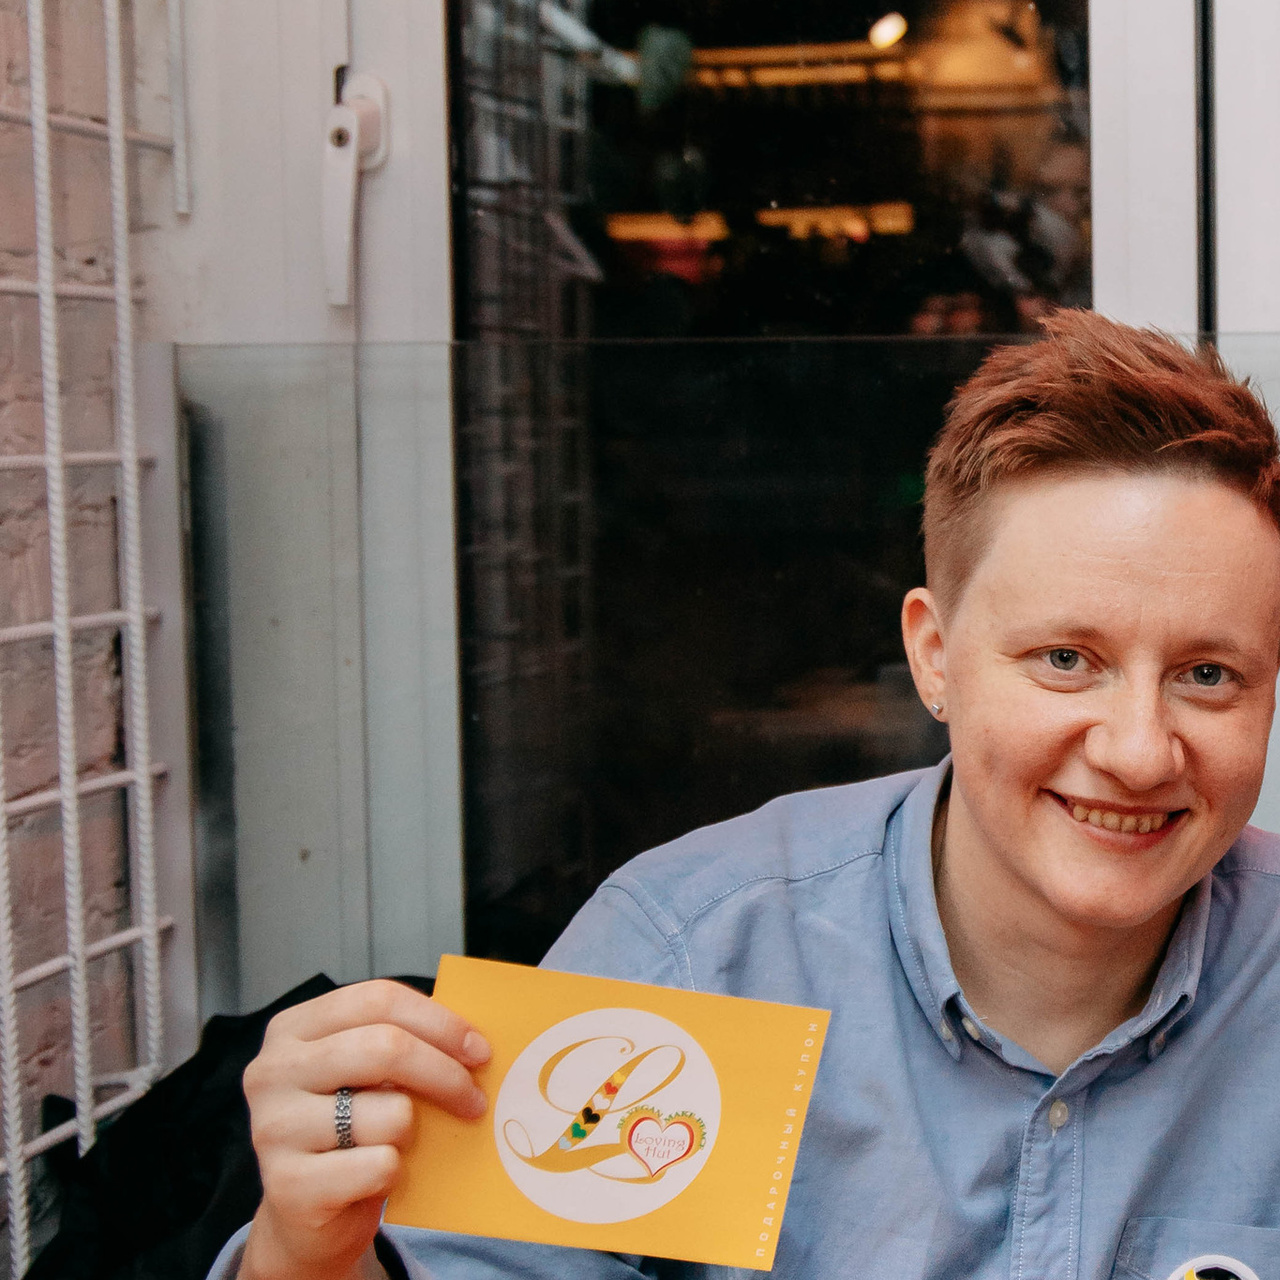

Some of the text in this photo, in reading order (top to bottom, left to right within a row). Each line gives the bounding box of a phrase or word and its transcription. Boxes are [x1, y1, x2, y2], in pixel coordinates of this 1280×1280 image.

[634, 1132, 686, 1151] Loving
[755, 1023, 818, 1257] ПОДАРОЧНЫЙ КУПОН
[645, 1146, 671, 1159] Hut
